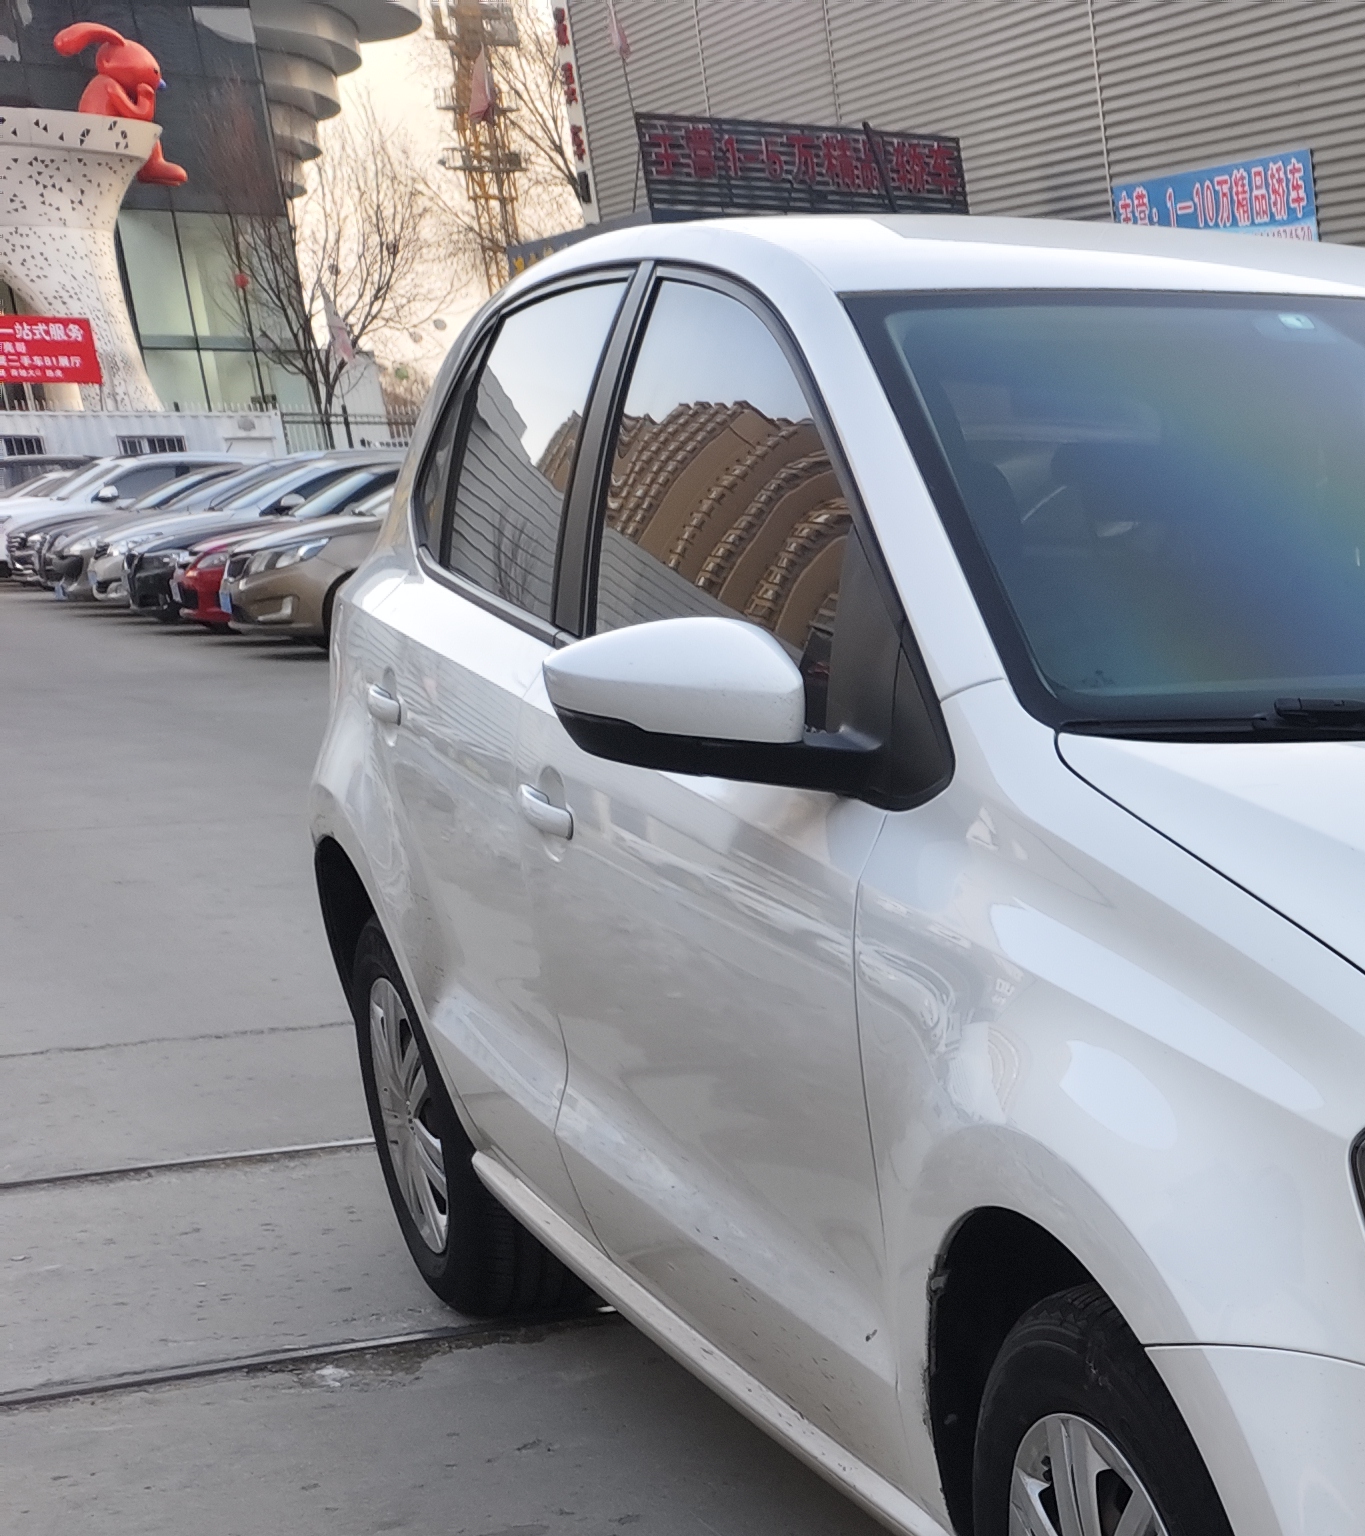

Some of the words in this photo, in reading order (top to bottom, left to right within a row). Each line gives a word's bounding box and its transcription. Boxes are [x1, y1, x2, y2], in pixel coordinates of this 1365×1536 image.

[0, 321, 84, 342] 一站式服务
